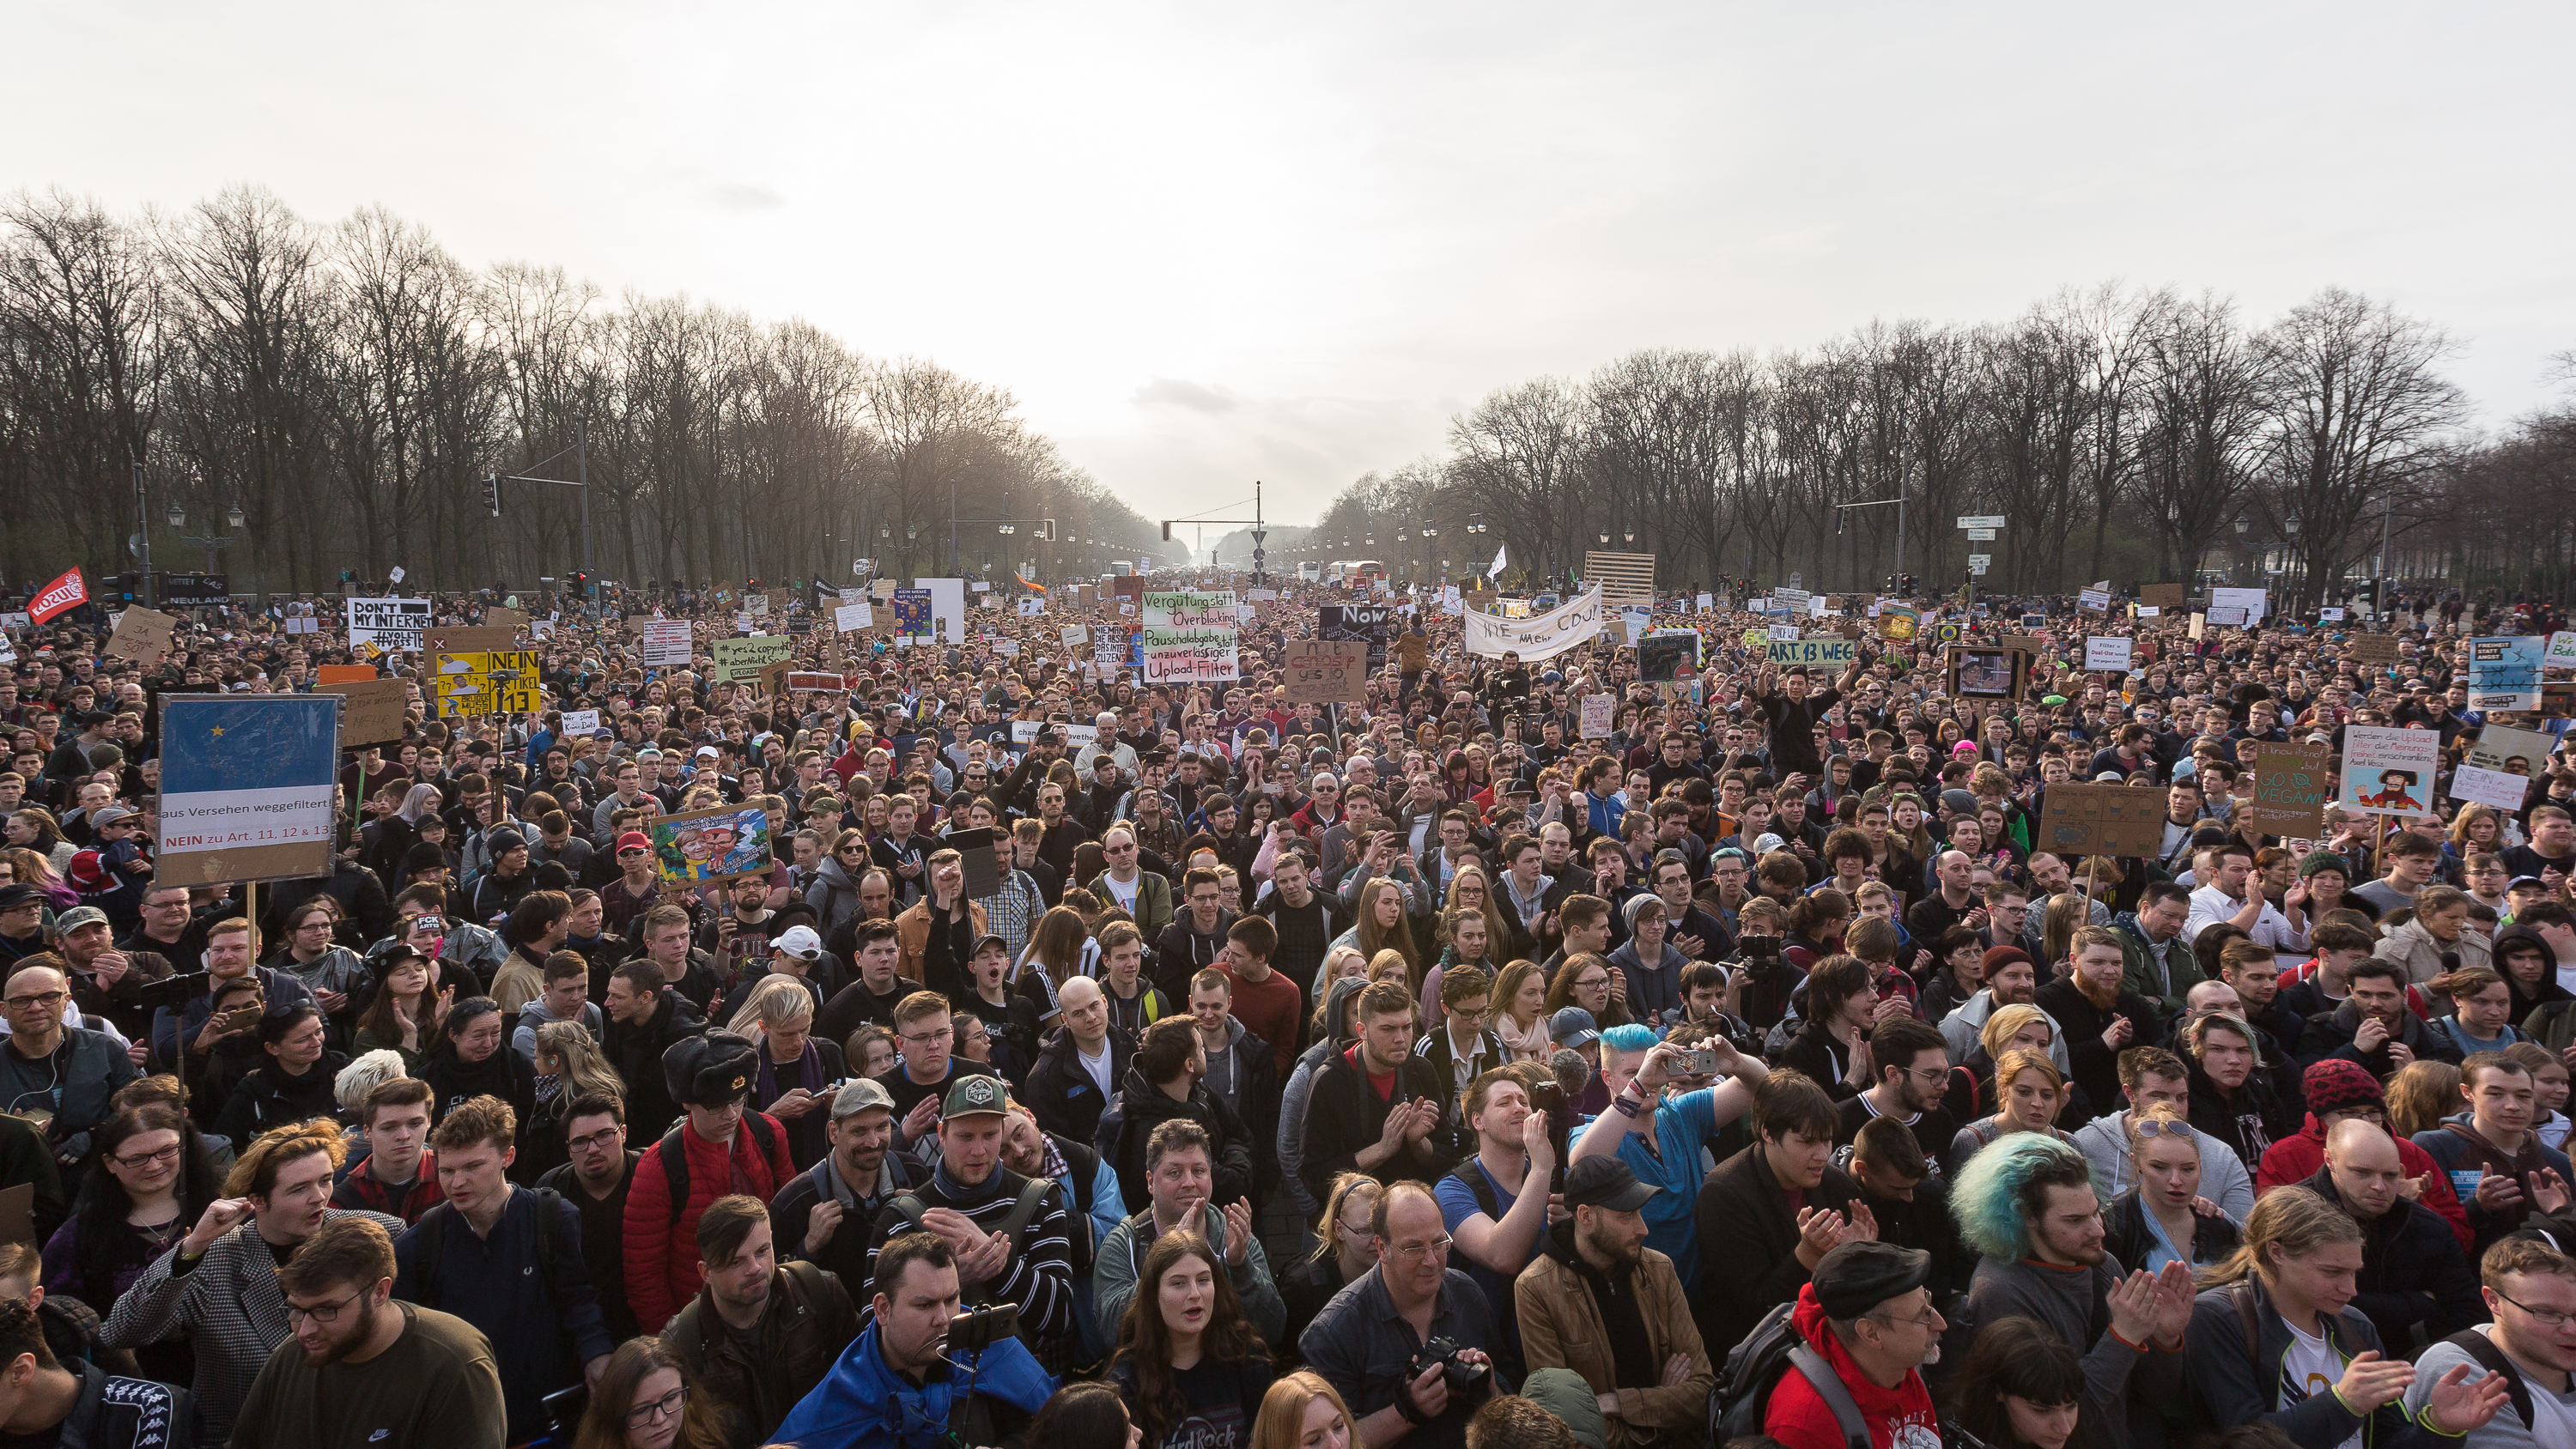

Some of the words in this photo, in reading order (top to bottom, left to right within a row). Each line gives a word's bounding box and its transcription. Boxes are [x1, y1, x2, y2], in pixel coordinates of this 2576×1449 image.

[1249, 590, 1273, 599] STOP
[354, 602, 397, 614] DON'T
[1143, 592, 1210, 615] Vergütung
[1211, 594, 1234, 606] statt
[354, 613, 369, 627] MY
[371, 615, 433, 627] INTERNET
[1173, 611, 1236, 628] Overblocking
[1557, 603, 1598, 631] CDU!
[132, 625, 149, 636] JA
[1145, 628, 1219, 647] Pauschalabgabe
[1217, 635, 1237, 648] statt
[1095, 634, 1105, 643] DIE
[1639, 640, 1662, 652] HALT
[1096, 653, 1105, 662] ZU
[1151, 647, 1231, 662] unzuverlässiger
[1768, 643, 1800, 662] ART.
[1803, 643, 1817, 662] 13
[1822, 643, 1854, 660] WEG
[2552, 644, 2576, 657] Bots
[490, 652, 538, 670] NEIN
[1149, 660, 1234, 682] Upload-Filter
[504, 691, 529, 712] 13
[581, 721, 596, 730] Bots
[2353, 731, 2384, 741] Werden
[2270, 746, 2292, 755] know
[2349, 757, 2366, 767] Axel
[2260, 772, 2286, 787] GO
[2459, 767, 2494, 784] NEIN
[2257, 786, 2324, 807] VEGAN!
[161, 808, 185, 820] aus
[189, 803, 250, 817] Versehen
[253, 797, 332, 815] weggefiltert!
[681, 822, 702, 831] ZENSUR
[720, 815, 748, 825] GESIEGT!
[166, 834, 203, 848] NEIN
[207, 834, 222, 844] zu
[227, 828, 253, 843] Art.
[258, 828, 279, 841] 11,
[283, 827, 298, 839] 12
[313, 824, 330, 836] 13
[732, 852, 760, 870] GEFANGEN
[418, 916, 439, 925] FCK
[1196, 1423, 1236, 1449] Rock
